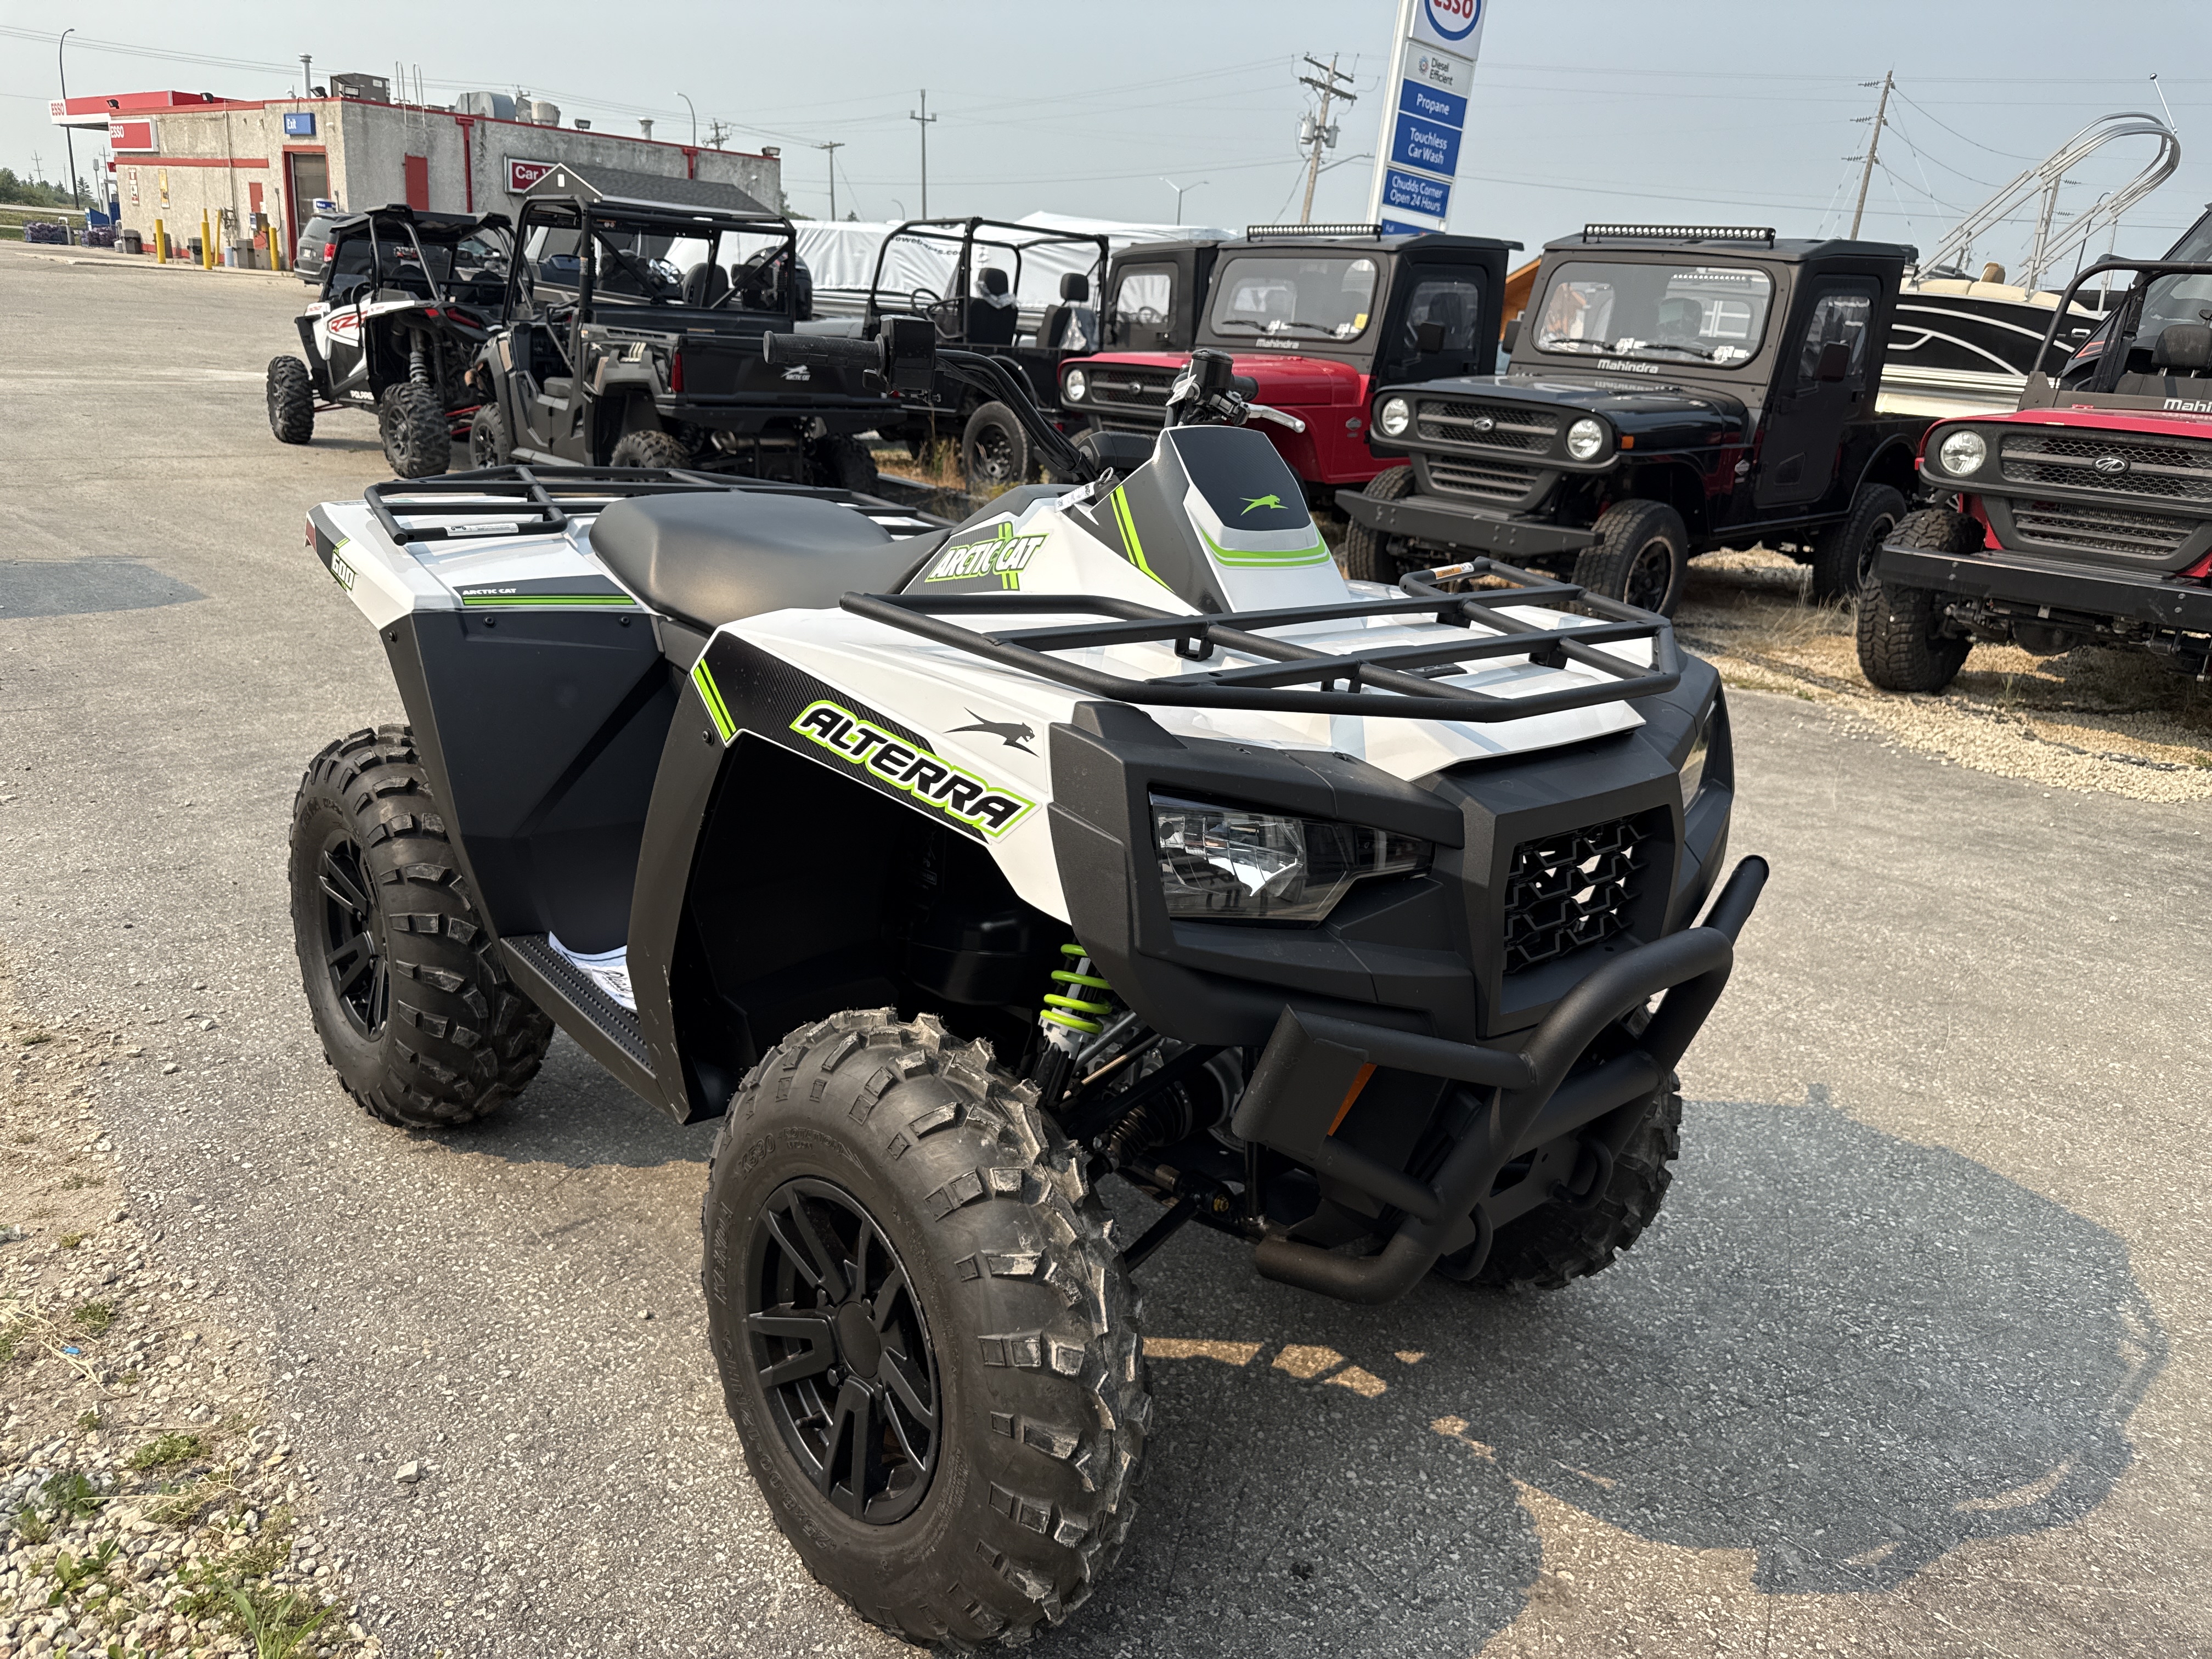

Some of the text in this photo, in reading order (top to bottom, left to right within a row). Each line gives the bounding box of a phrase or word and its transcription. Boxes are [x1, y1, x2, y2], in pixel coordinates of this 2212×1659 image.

[1431, 58, 1449, 72] Diesel
[1429, 69, 1453, 86] Efficient
[1417, 93, 1450, 116] Propane
[287, 118, 297, 129] Exit
[1410, 127, 1448, 150] Touchless
[1408, 143, 1444, 165] Car Wash
[516, 165, 539, 180] Car
[1392, 175, 1443, 199] Chudds Corner
[1390, 188, 1441, 212] Open 24 Hours
[1255, 337, 1300, 349] Mahindra
[1597, 359, 1658, 374] Mahindra
[2163, 398, 2212, 412] Mahi
[927, 536, 1046, 579] ARCTIC CAT
[331, 552, 355, 590] 600
[799, 707, 1023, 830] ALTERRA
[783, 1126, 844, 1154] ROTATION
[713, 1201, 733, 1306] KENDA
